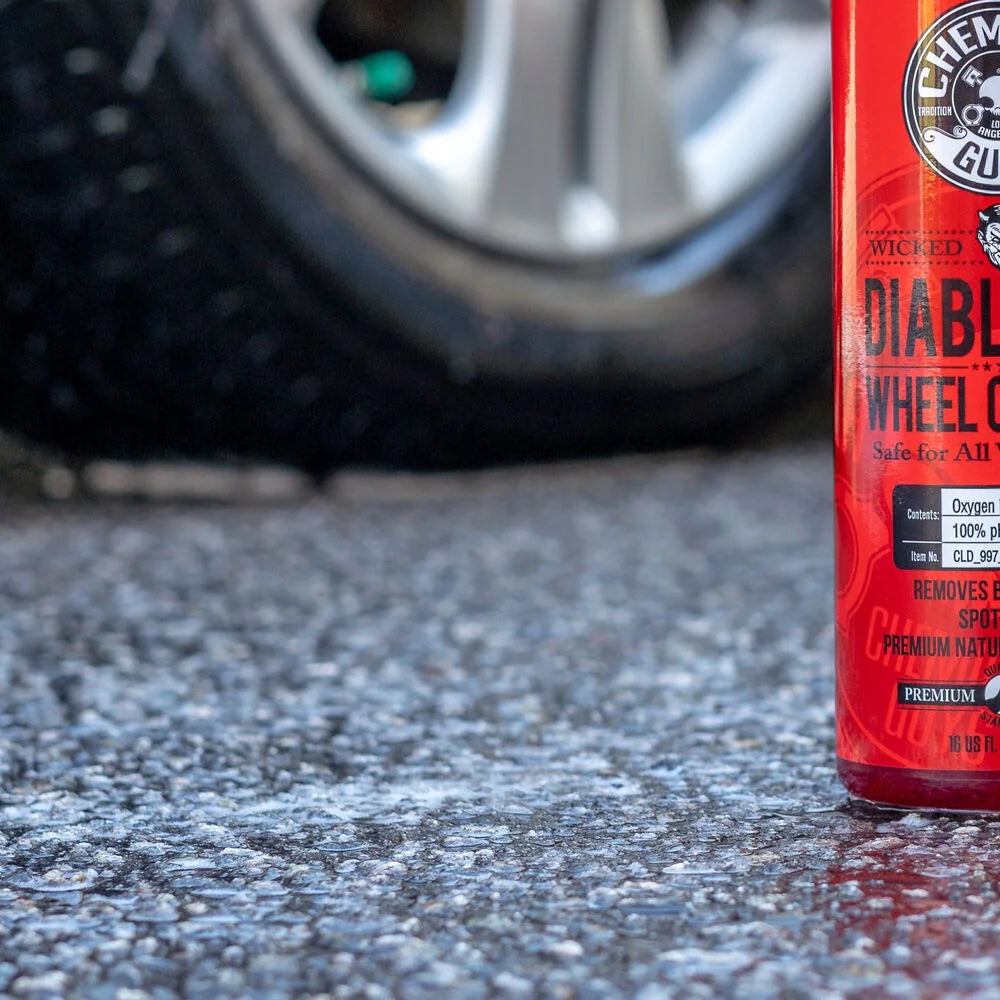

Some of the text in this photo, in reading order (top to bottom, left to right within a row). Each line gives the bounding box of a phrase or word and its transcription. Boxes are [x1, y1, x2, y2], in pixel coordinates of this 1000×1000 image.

[918, 106, 952, 116] TRADITION
[869, 239, 963, 257] WICKED
[866, 374, 978, 433] WHEEL
[872, 441, 912, 462] Safe
[917, 441, 948, 462] for
[953, 442, 991, 462] All
[907, 509, 940, 521] Contents:
[952, 498, 995, 516] Oxygen
[952, 523, 986, 539] 100%
[911, 550, 940, 562] Item No.
[913, 580, 988, 600] REMOVES
[884, 635, 950, 657] PREMIUM
[904, 687, 976, 703] PREMIUM
[948, 736, 961, 753] 16
[965, 736, 981, 752] US
